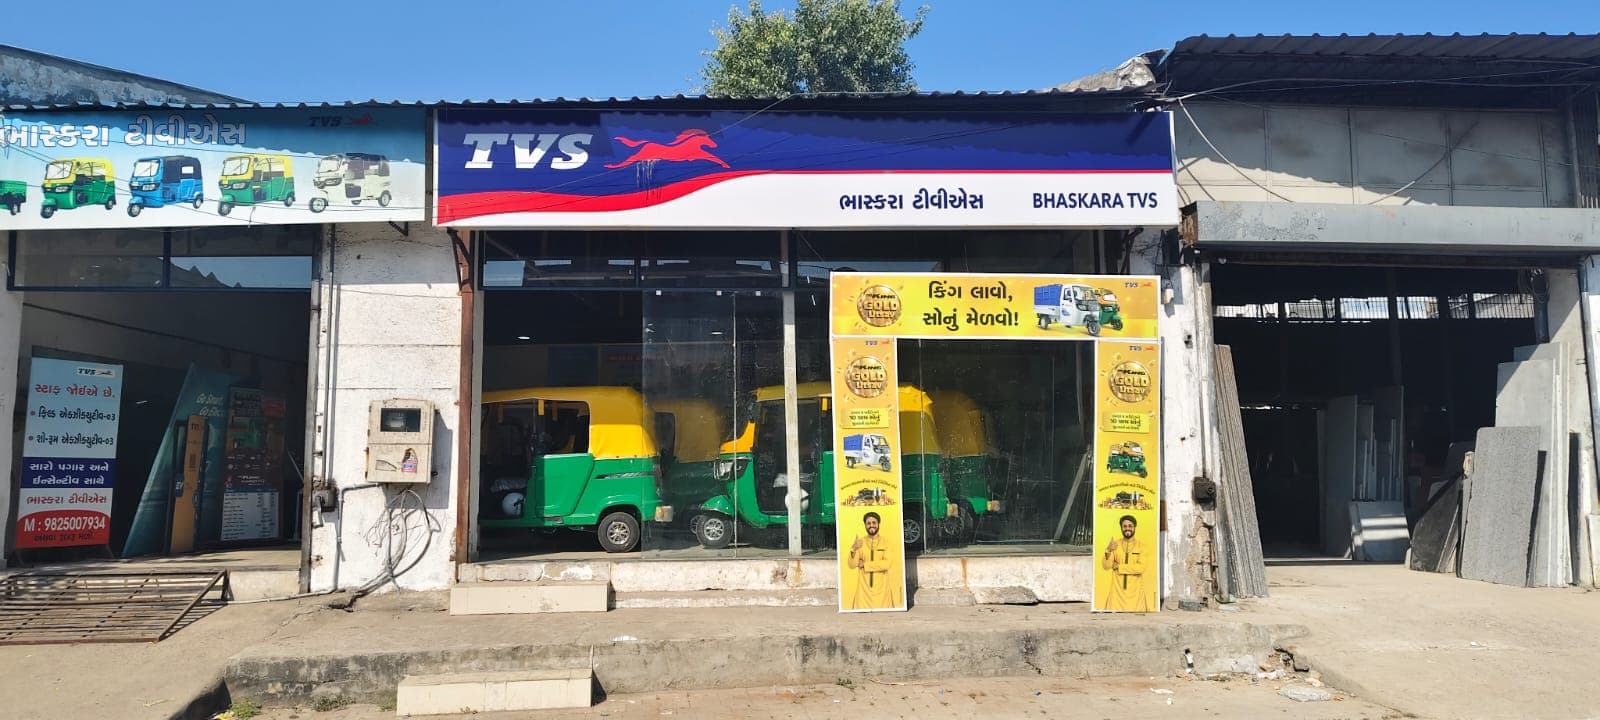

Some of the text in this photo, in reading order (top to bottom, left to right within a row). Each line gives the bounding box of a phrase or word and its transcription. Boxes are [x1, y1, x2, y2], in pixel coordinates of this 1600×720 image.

[309, 116, 342, 127] TVS
[124, 114, 246, 146] ટીવીએસ
[462, 133, 593, 170] TVS
[839, 187, 984, 210] ભાસ્કરા ટીવીએસ
[1033, 192, 1158, 209] BHASKARA TVS
[1124, 280, 1138, 288] TVS
[928, 280, 1013, 302] કિંગ લાવો,
[863, 301, 897, 311] GOLD
[923, 307, 1018, 331] સોનું મેળવો!
[852, 372, 885, 382] GOLD
[1114, 376, 1148, 387] GOLD
[34, 384, 61, 396] સ્ટાફ
[103, 385, 115, 398] છે.
[30, 461, 109, 471] સારો પગાર અને
[83, 475, 104, 485] સાથે
[26, 493, 106, 504] ભાસ્કરા ટીવીએસ
[24, 518, 35, 531] M
[44, 516, 106, 531] 9825007934
